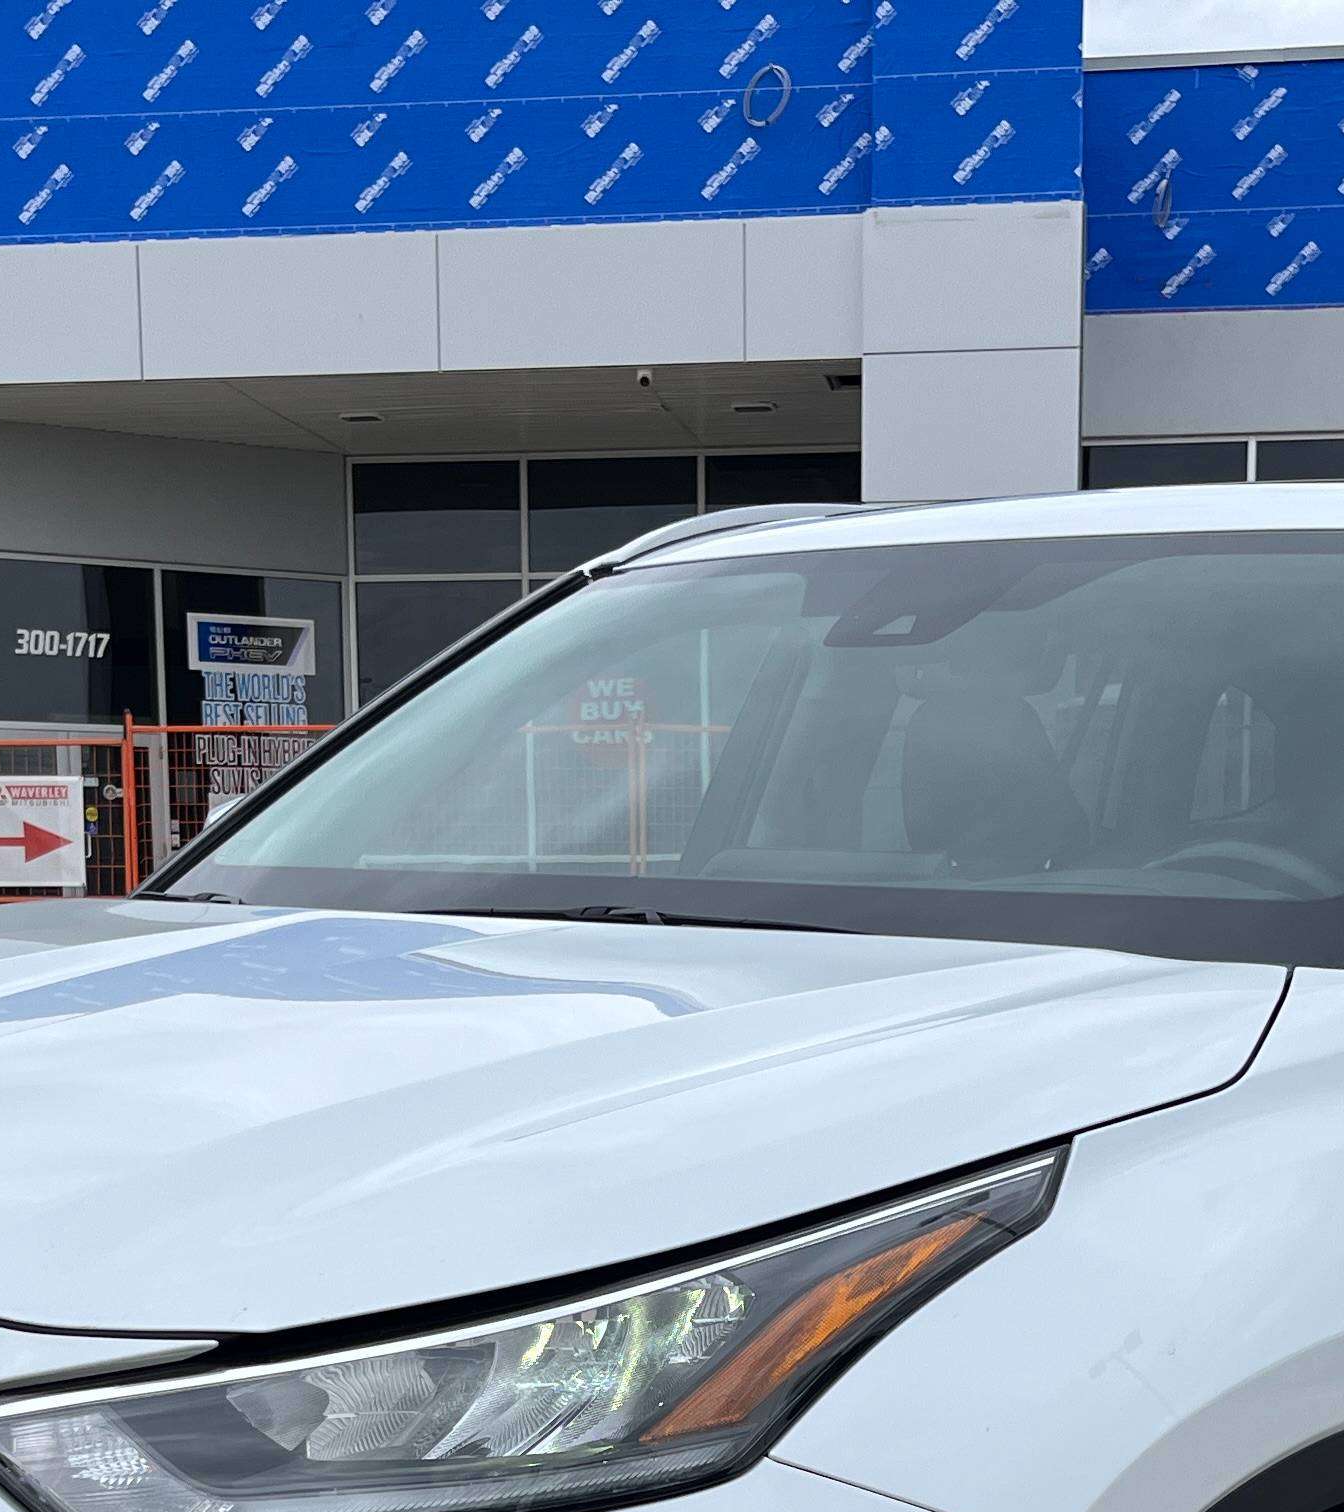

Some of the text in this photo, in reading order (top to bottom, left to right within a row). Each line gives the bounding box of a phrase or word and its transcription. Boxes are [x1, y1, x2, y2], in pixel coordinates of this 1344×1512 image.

[15, 629, 111, 658] 300-1717
[209, 635, 283, 648] OUTLANDER
[203, 672, 306, 703] THE WORLD'S
[587, 679, 635, 698] WE
[203, 702, 242, 726] BEST
[581, 701, 645, 721] BUY
[196, 735, 258, 765] PLUG-IN
[10, 787, 68, 799] WAVERLEY
[211, 768, 244, 795] SUV
